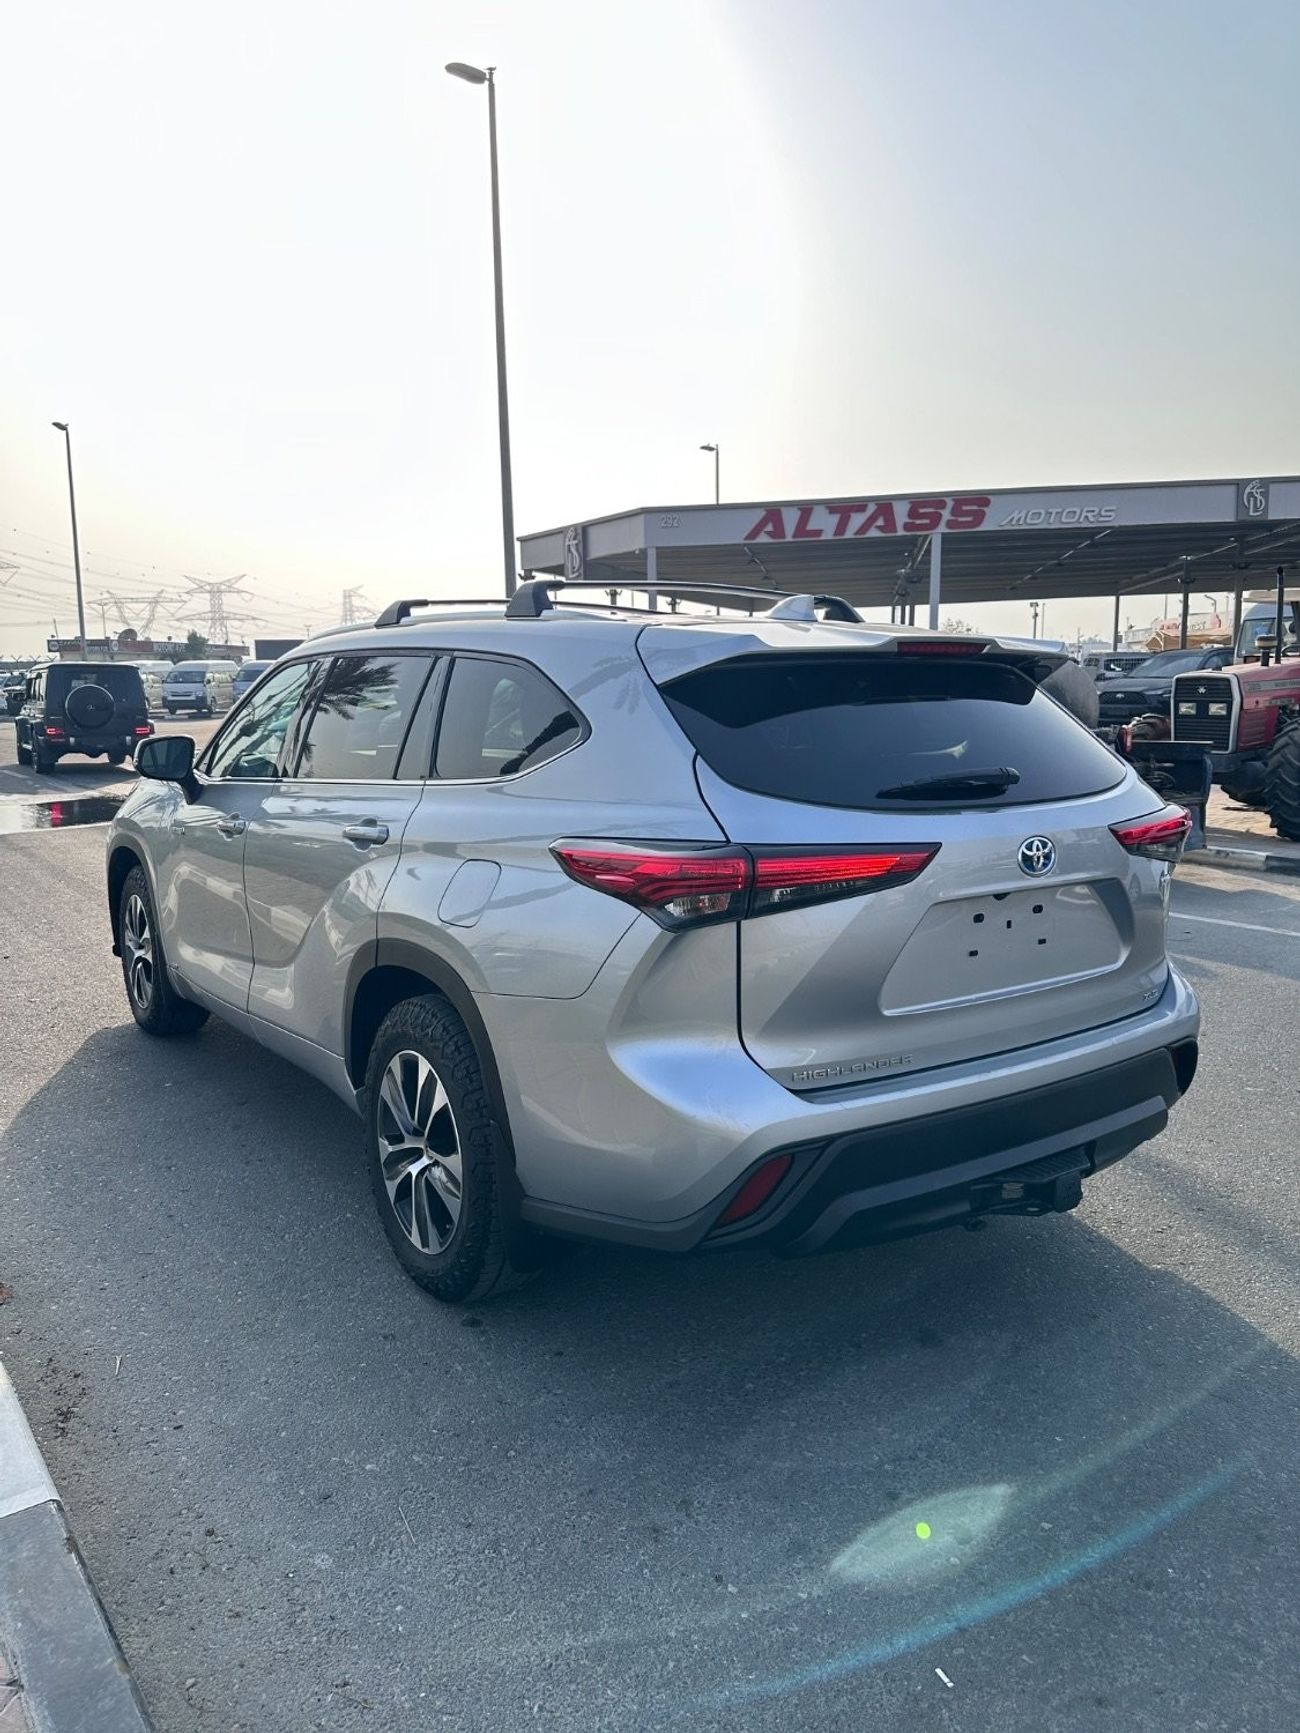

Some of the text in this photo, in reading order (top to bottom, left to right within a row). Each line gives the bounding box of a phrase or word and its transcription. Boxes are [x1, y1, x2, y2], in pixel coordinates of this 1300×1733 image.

[660, 513, 681, 528] 292
[743, 496, 1118, 541] ALTASS MOTORS
[791, 1053, 914, 1082] HIGHLANDER
